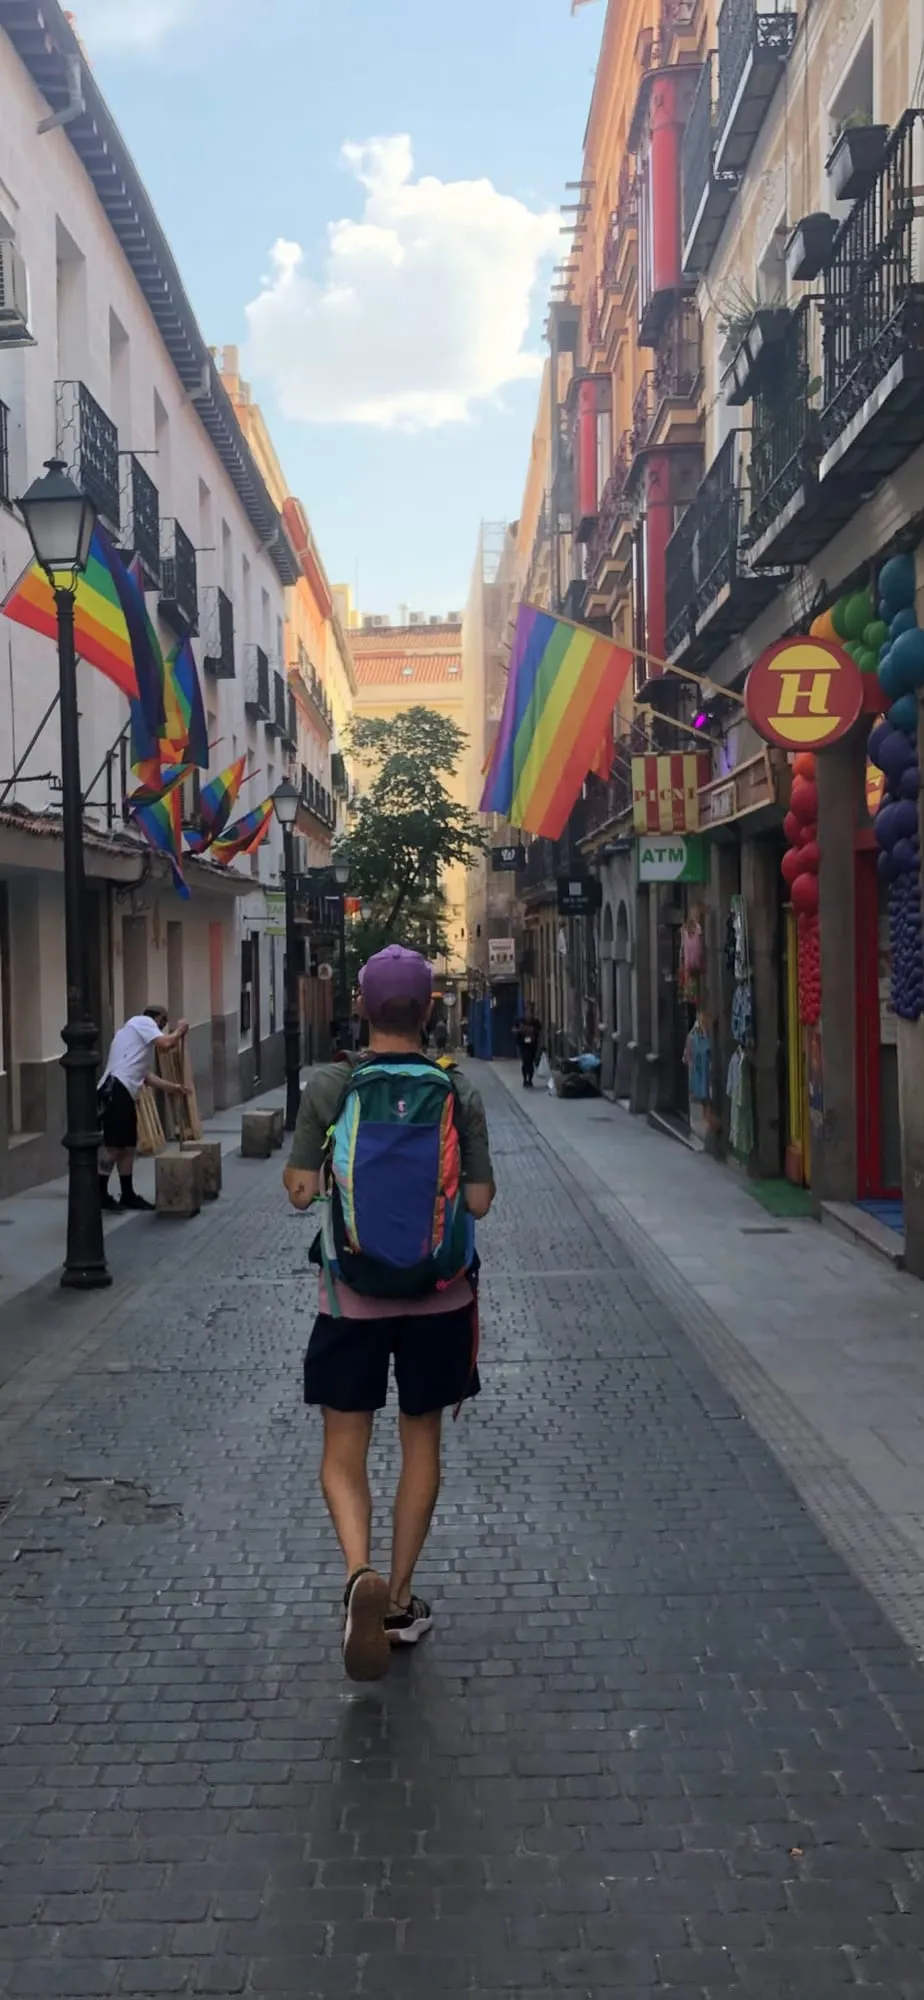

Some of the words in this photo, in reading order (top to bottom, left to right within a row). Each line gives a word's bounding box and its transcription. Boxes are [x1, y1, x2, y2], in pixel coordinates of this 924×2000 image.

[777, 673, 831, 714] H
[634, 787, 696, 802] PICNI
[641, 848, 683, 863] ATM
